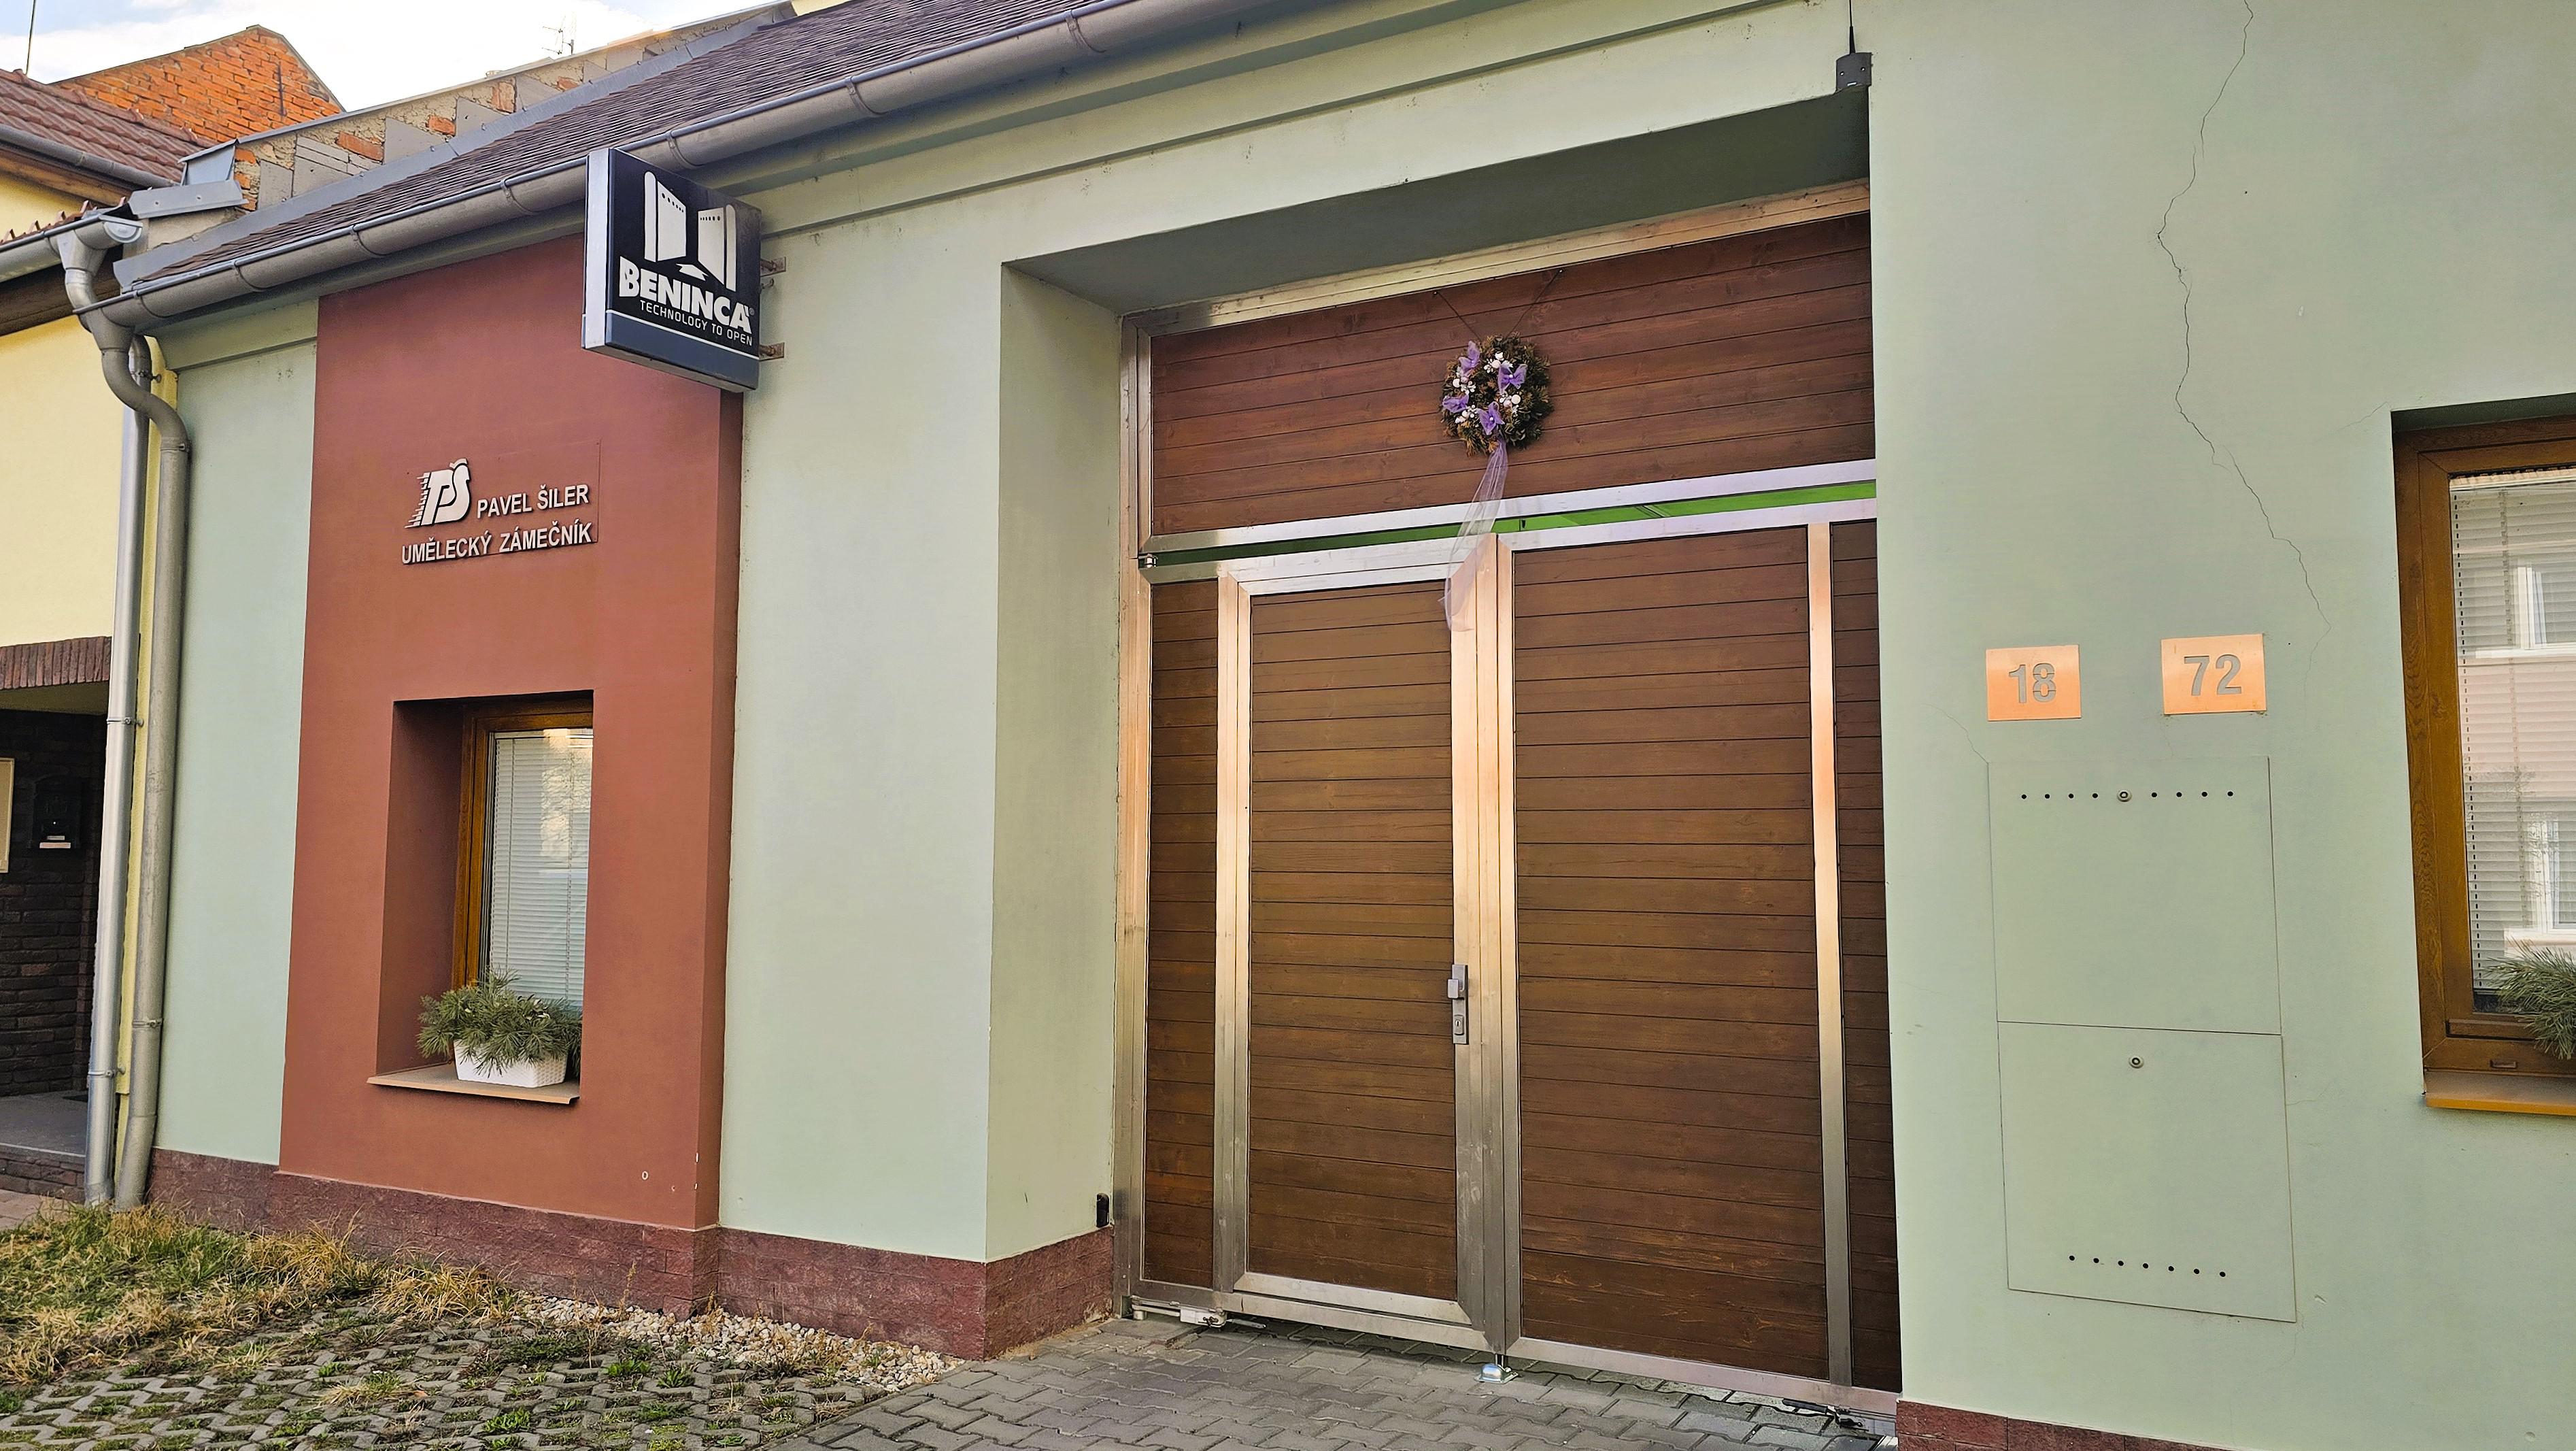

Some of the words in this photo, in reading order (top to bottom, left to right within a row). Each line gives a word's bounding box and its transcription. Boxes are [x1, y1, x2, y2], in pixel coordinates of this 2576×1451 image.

[639, 299, 707, 331] TECHNOLOGY
[711, 322, 723, 336] TO
[726, 329, 752, 346] OPEN
[477, 493, 532, 519] PAVEL
[537, 484, 589, 510] ŠILER
[401, 529, 492, 565] UMĚLECKÝ
[498, 518, 592, 554] ZÁMEČNÍK
[2008, 663, 2056, 704] 18
[2184, 654, 2241, 697] 72
